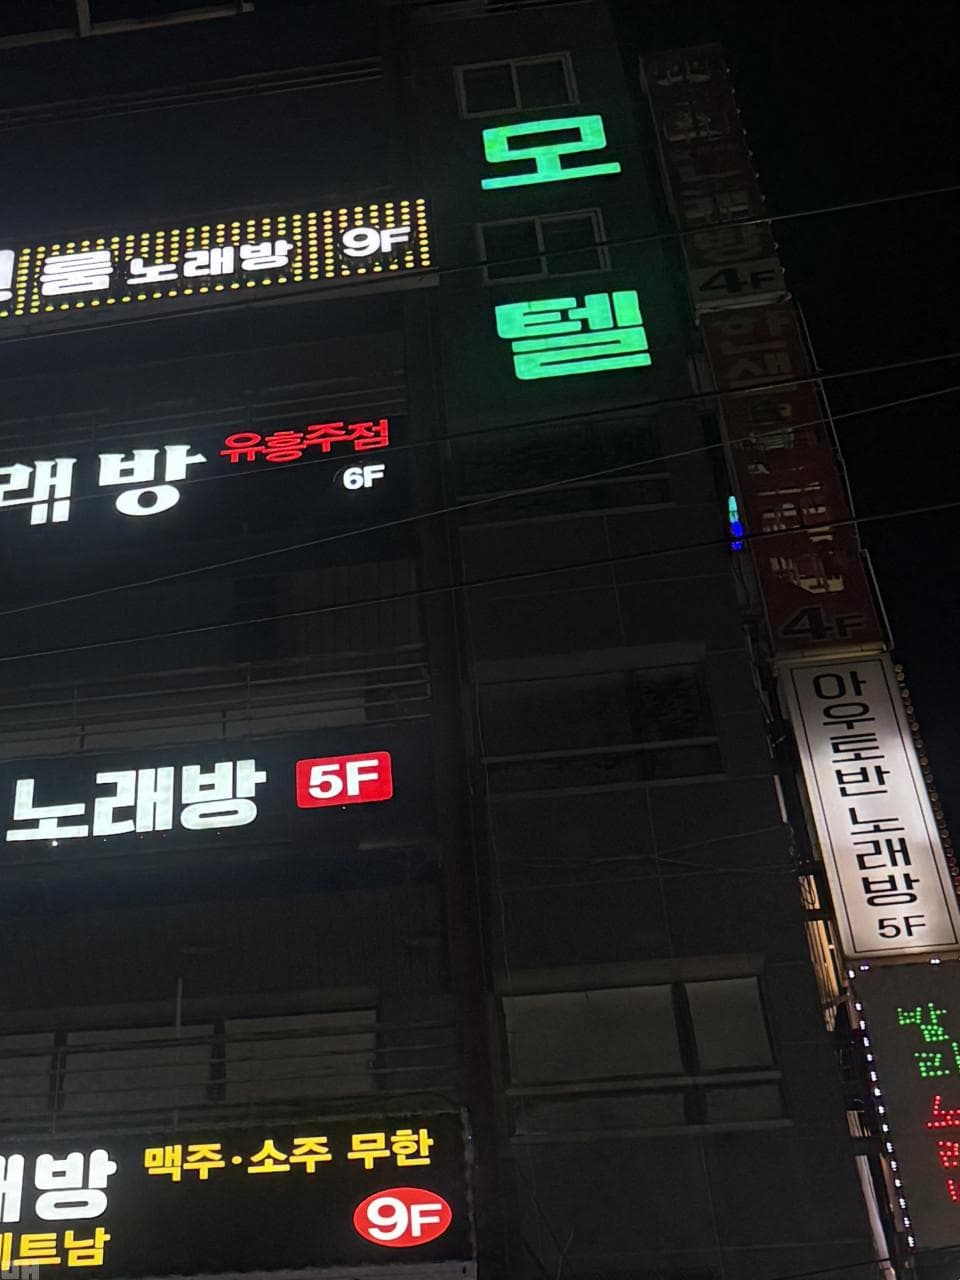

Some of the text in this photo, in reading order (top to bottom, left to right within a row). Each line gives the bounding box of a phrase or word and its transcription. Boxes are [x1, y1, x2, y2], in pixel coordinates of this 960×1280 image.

[128, 238, 295, 285] 노래방
[342, 225, 412, 258] 9F
[482, 114, 652, 380] 모텔
[699, 267, 775, 294] 4F
[219, 418, 391, 466] 유흥주점
[342, 464, 386, 491] 6F
[779, 604, 864, 641] 4F
[5, 759, 267, 843] 노래방
[308, 759, 380, 799] 5F
[812, 671, 920, 907] 아우토반 노래방
[878, 915, 926, 939] 5F
[144, 1128, 435, 1182] 맥주·소주 무한
[366, 1196, 442, 1241] 9F
